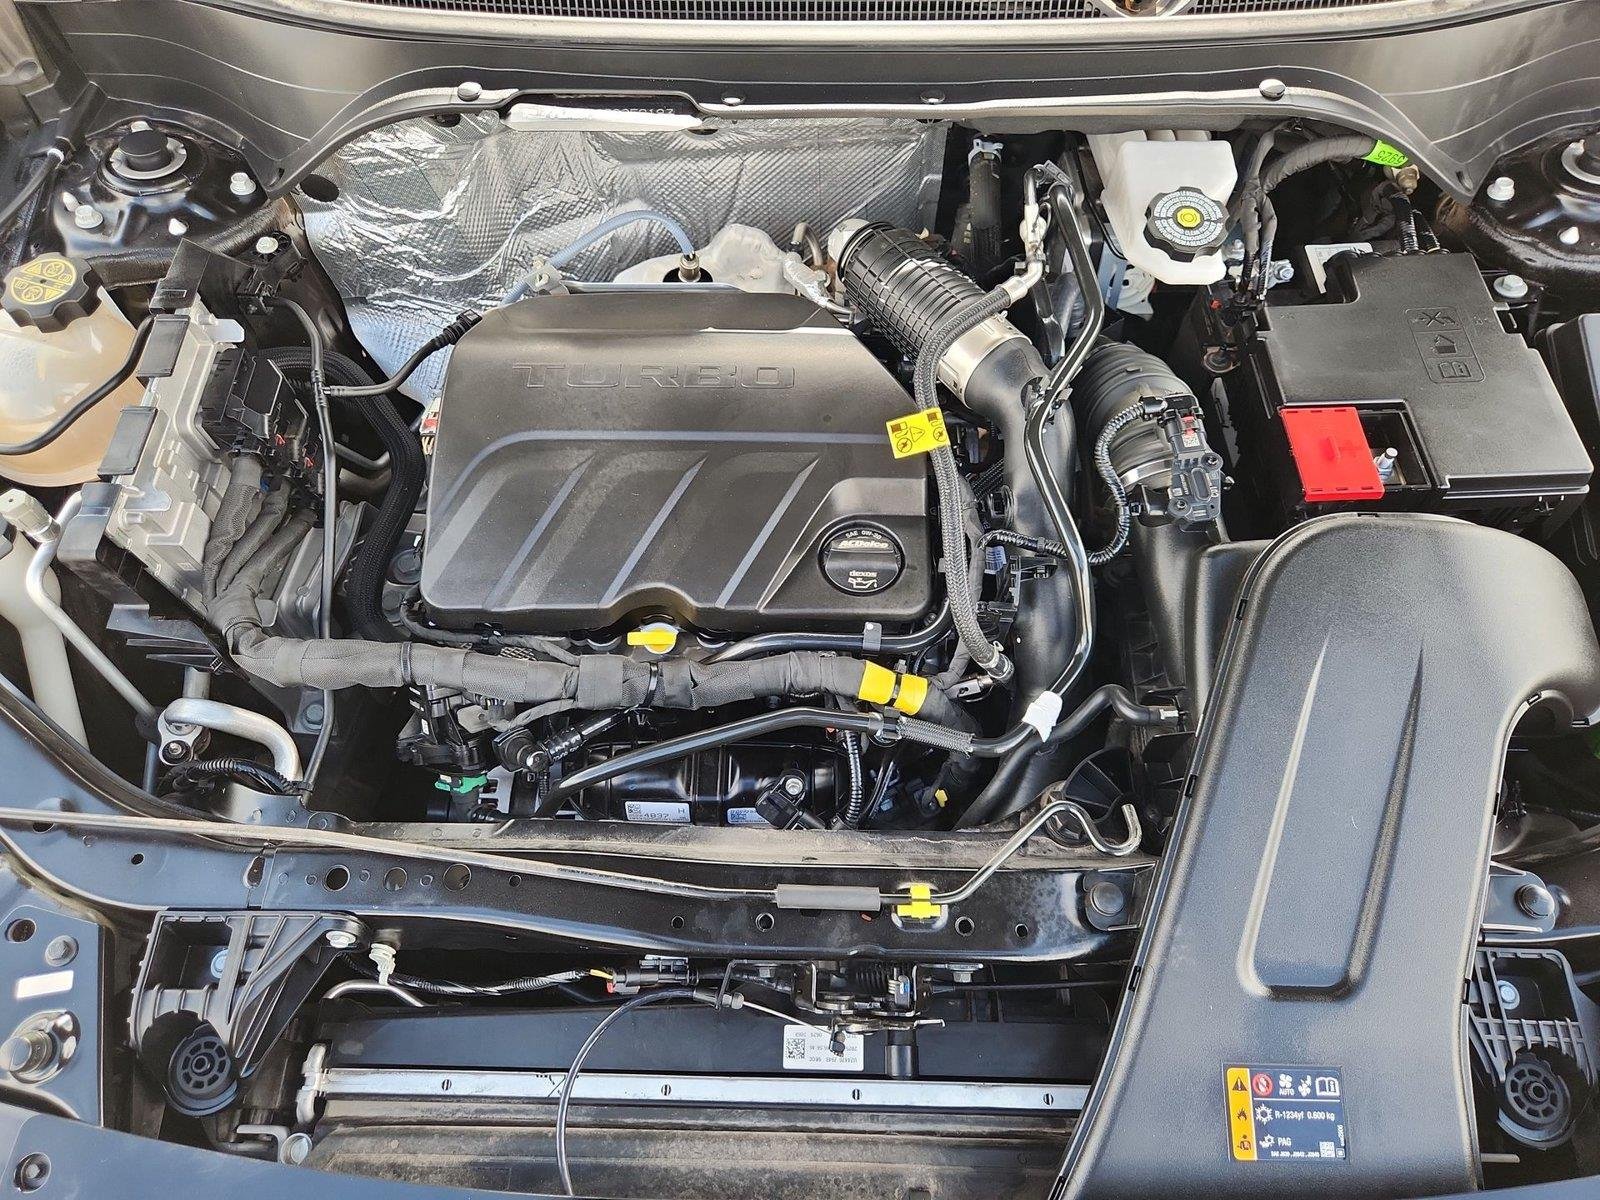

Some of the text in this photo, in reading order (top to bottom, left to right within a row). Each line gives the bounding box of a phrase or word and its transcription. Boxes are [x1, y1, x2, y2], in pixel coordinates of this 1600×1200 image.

[512, 362, 795, 389] TURBO
[838, 540, 889, 549] ACDelco
[849, 570, 877, 578] dexos
[1279, 1088, 1295, 1096] AUTO
[1274, 1110, 1335, 1121] R-1234yf 0.600 kg
[1277, 1137, 1292, 1147] PAG
